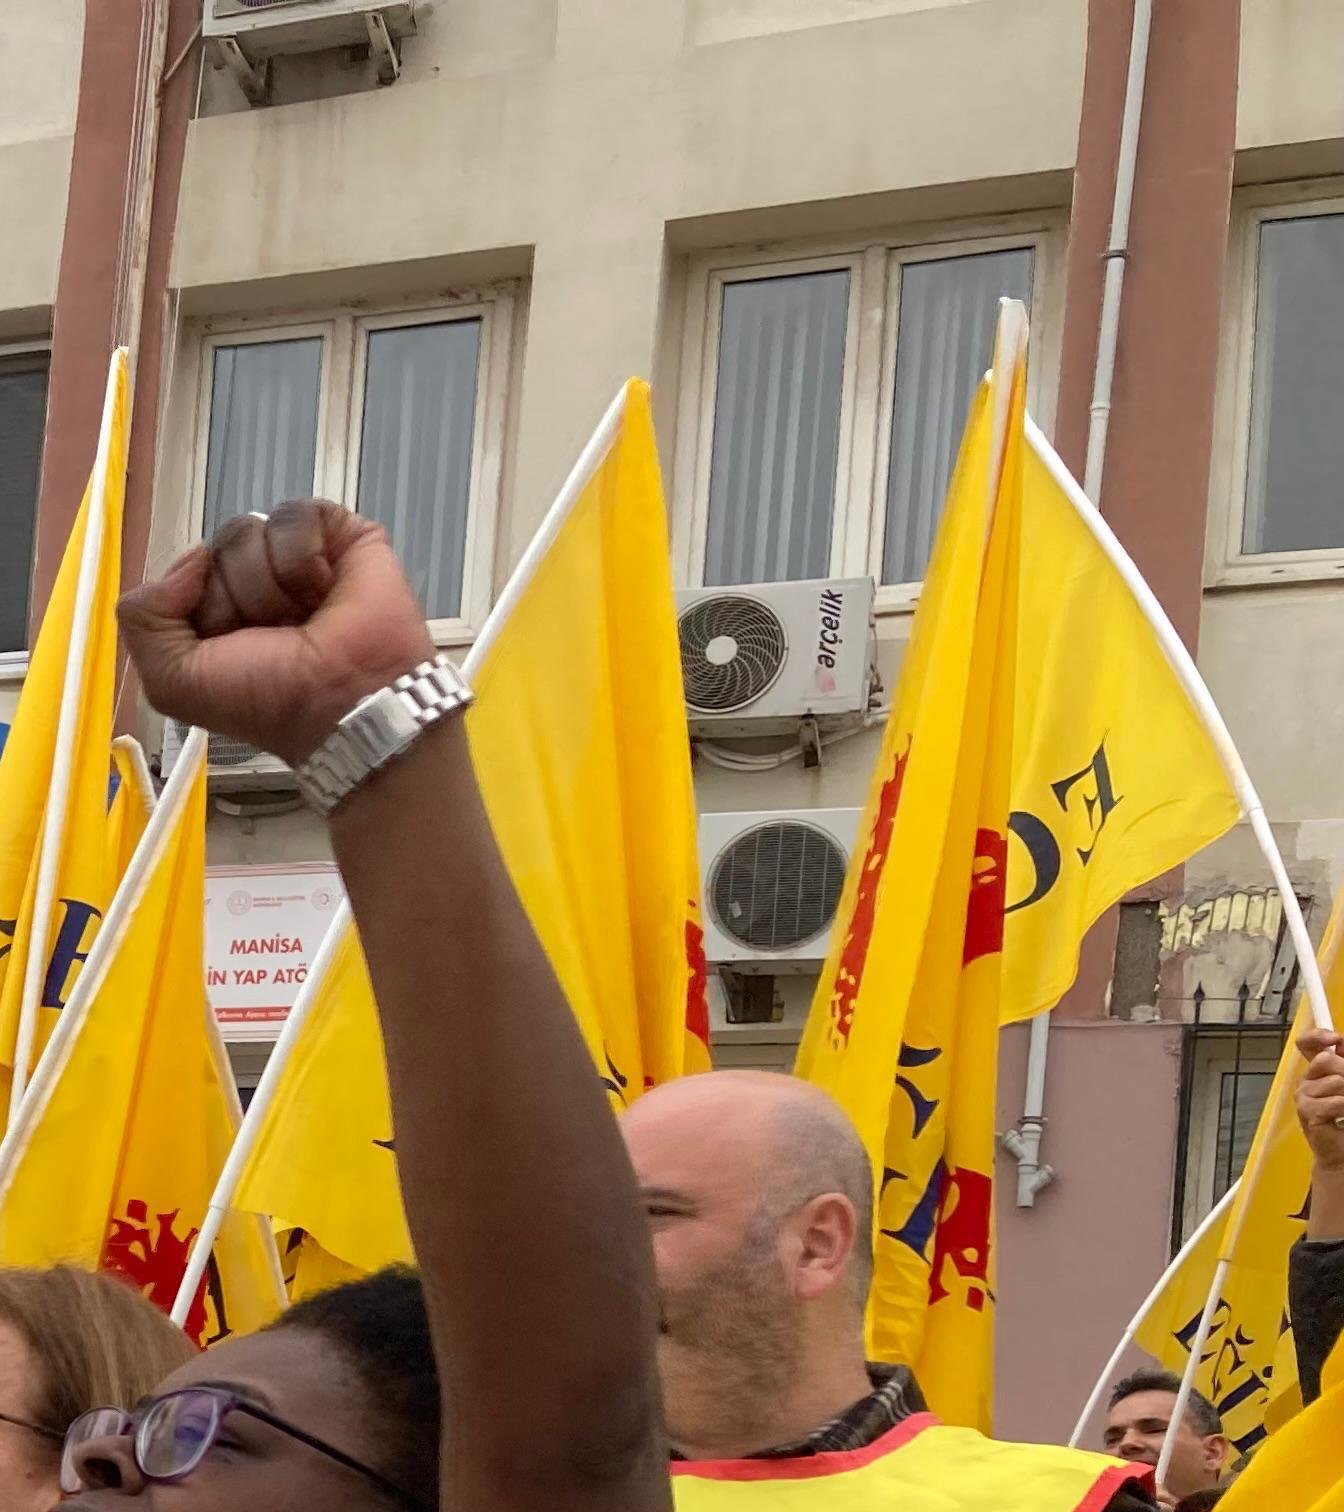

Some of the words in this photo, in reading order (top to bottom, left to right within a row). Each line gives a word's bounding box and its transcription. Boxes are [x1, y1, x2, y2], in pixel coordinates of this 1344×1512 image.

[817, 589, 843, 668] arçelik
[230, 932, 303, 955] MANİSA
[233, 969, 268, 986] YAP
